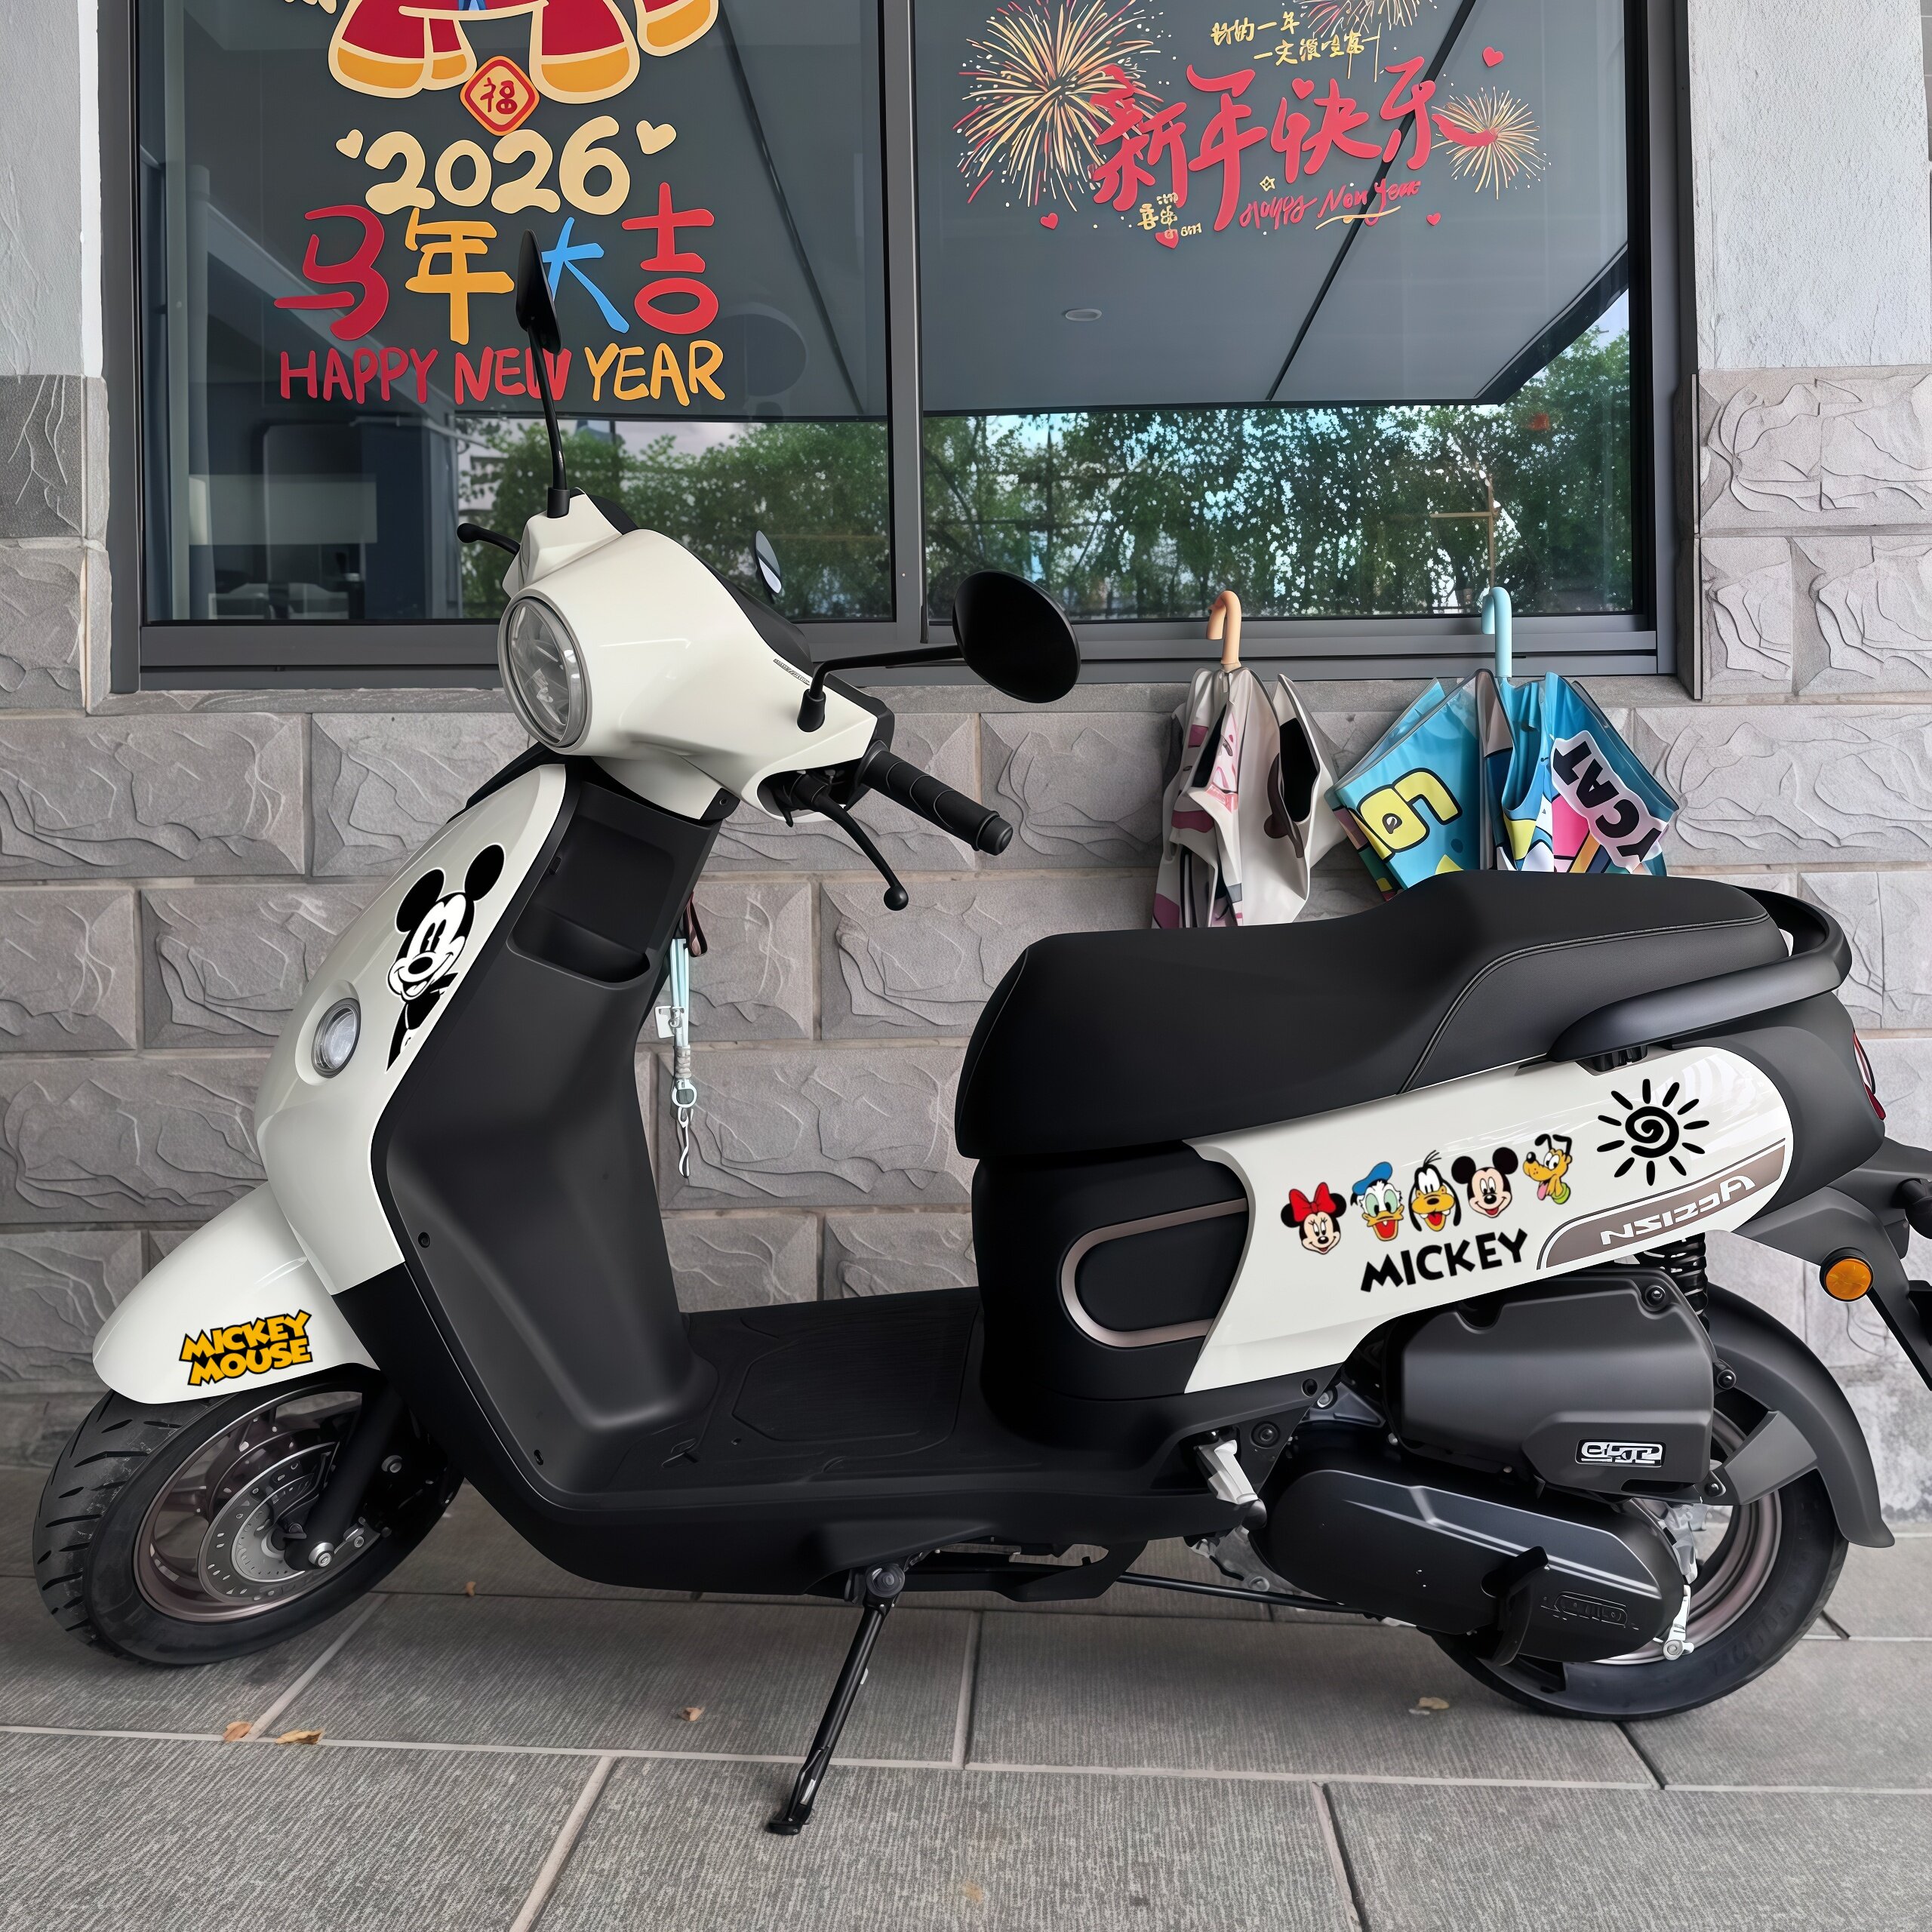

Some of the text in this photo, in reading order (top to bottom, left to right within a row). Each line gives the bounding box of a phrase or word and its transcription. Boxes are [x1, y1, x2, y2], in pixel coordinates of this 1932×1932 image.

[481, 78, 518, 115] 福
[365, 115, 631, 216] 2026
[1093, 56, 1496, 231] 新年快乐
[274, 181, 719, 345] 马年大吉
[280, 340, 725, 407] HAPPY NEW YEAR
[1360, 1228, 1528, 1293] MICKEY
[179, 1309, 312, 1361] MICKEY
[187, 1337, 313, 1386] MOUSE
